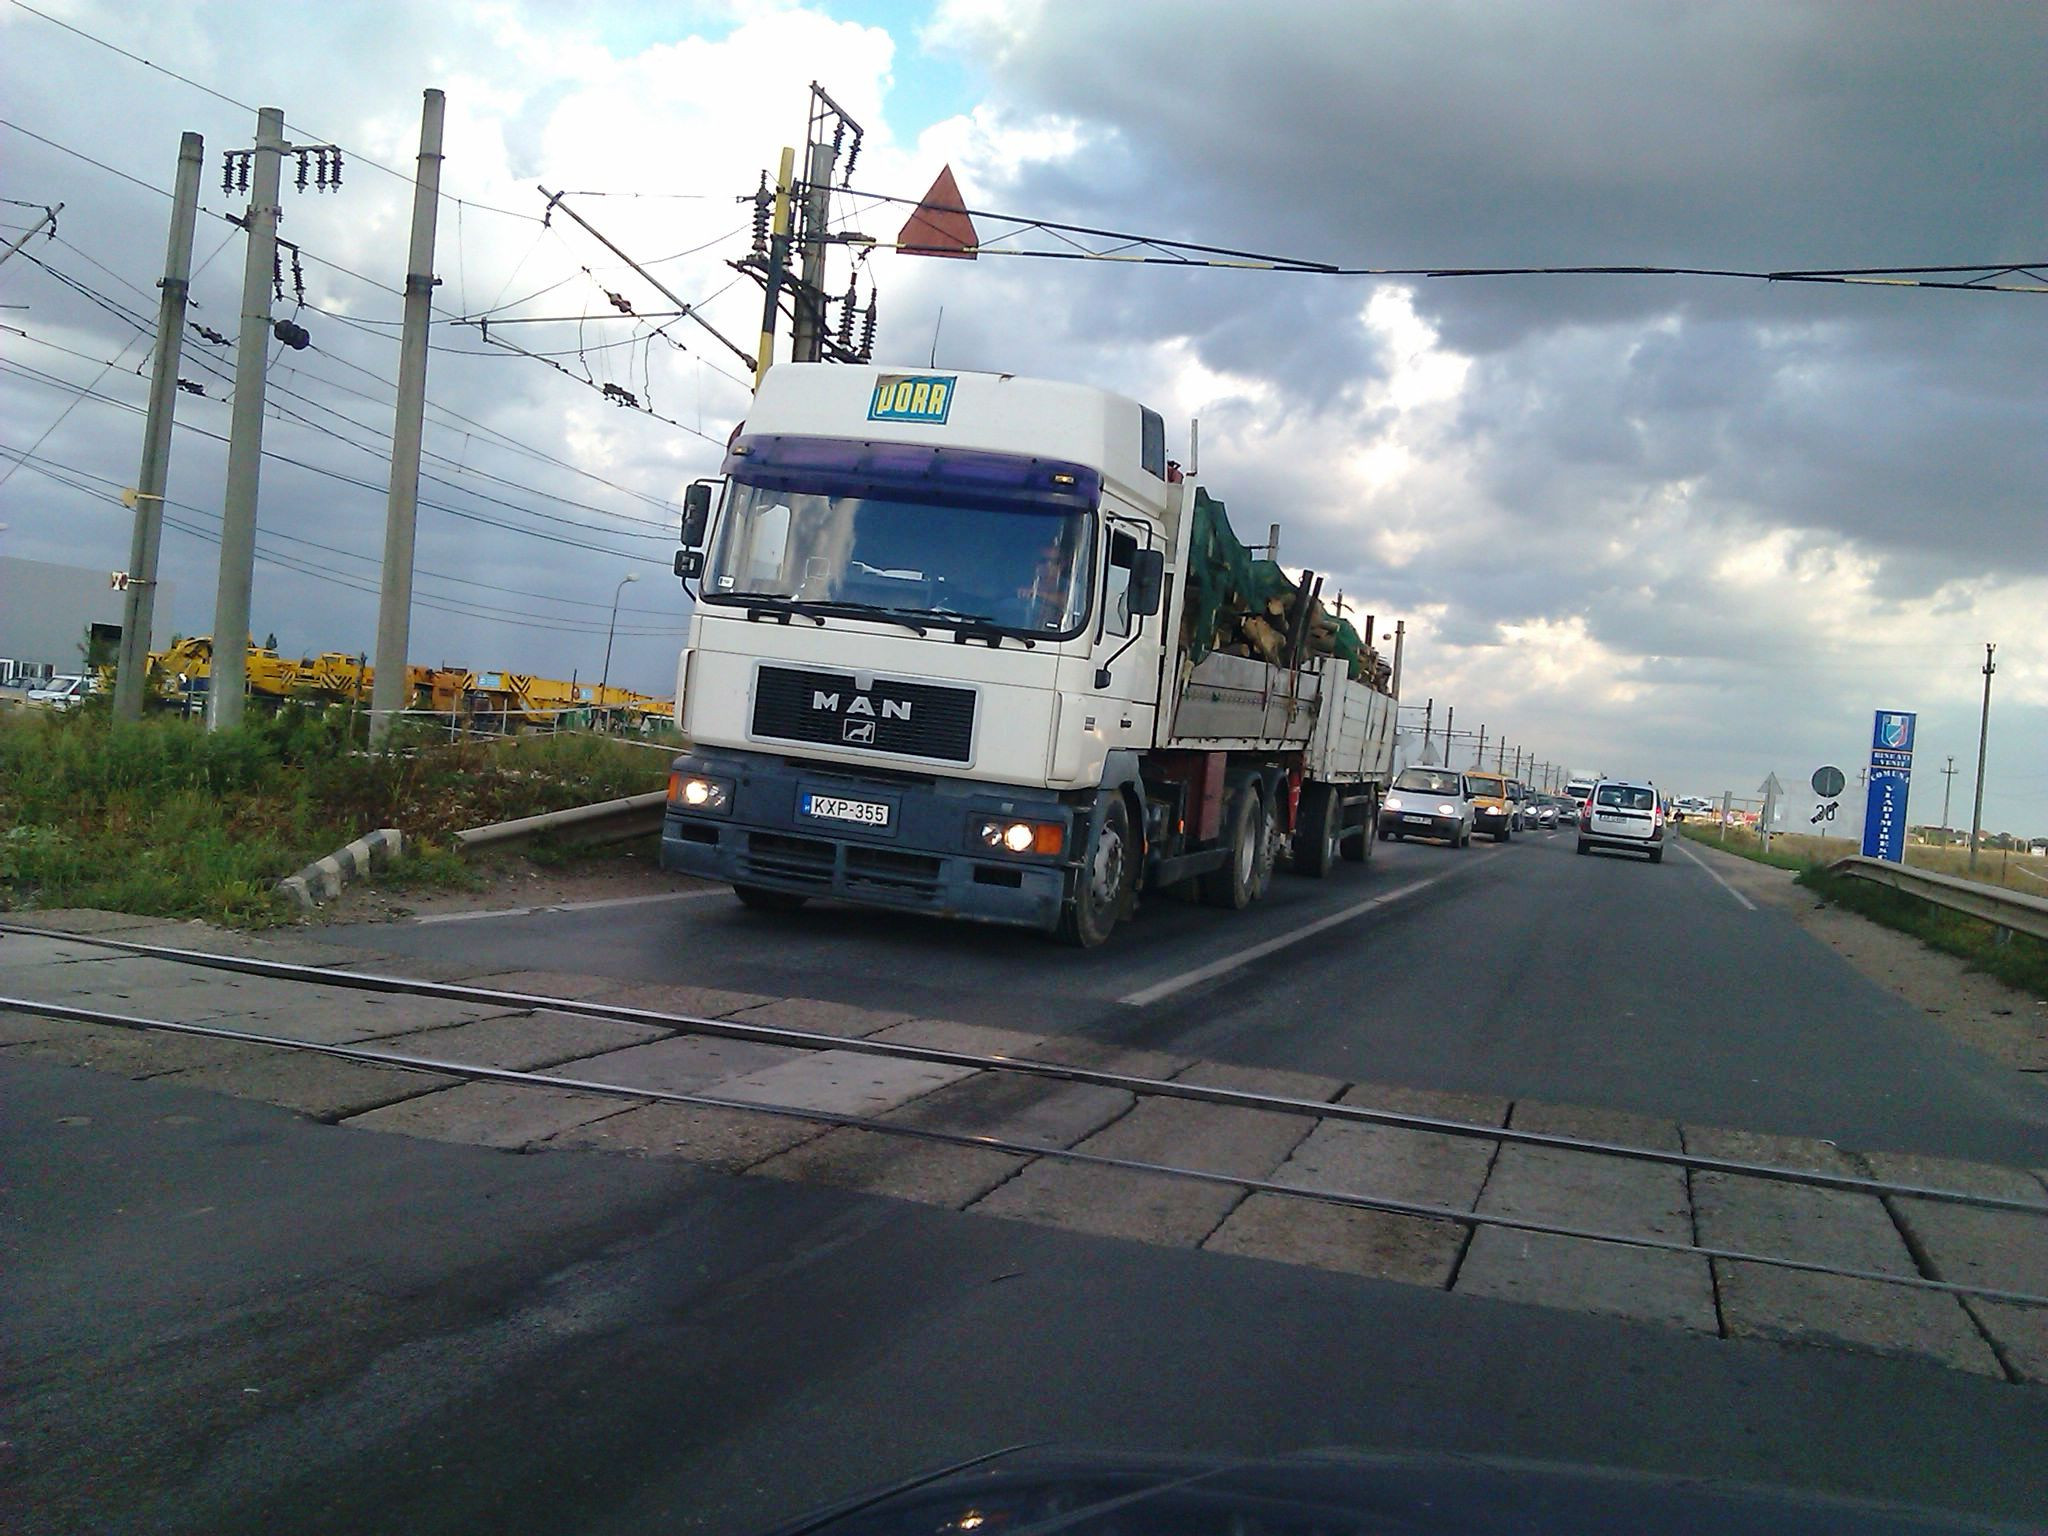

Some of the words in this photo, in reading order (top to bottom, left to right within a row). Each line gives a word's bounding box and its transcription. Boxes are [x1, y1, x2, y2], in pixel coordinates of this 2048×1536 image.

[876, 382, 947, 414] PORR
[812, 691, 912, 720] MAN
[814, 798, 884, 822] KXP-355
